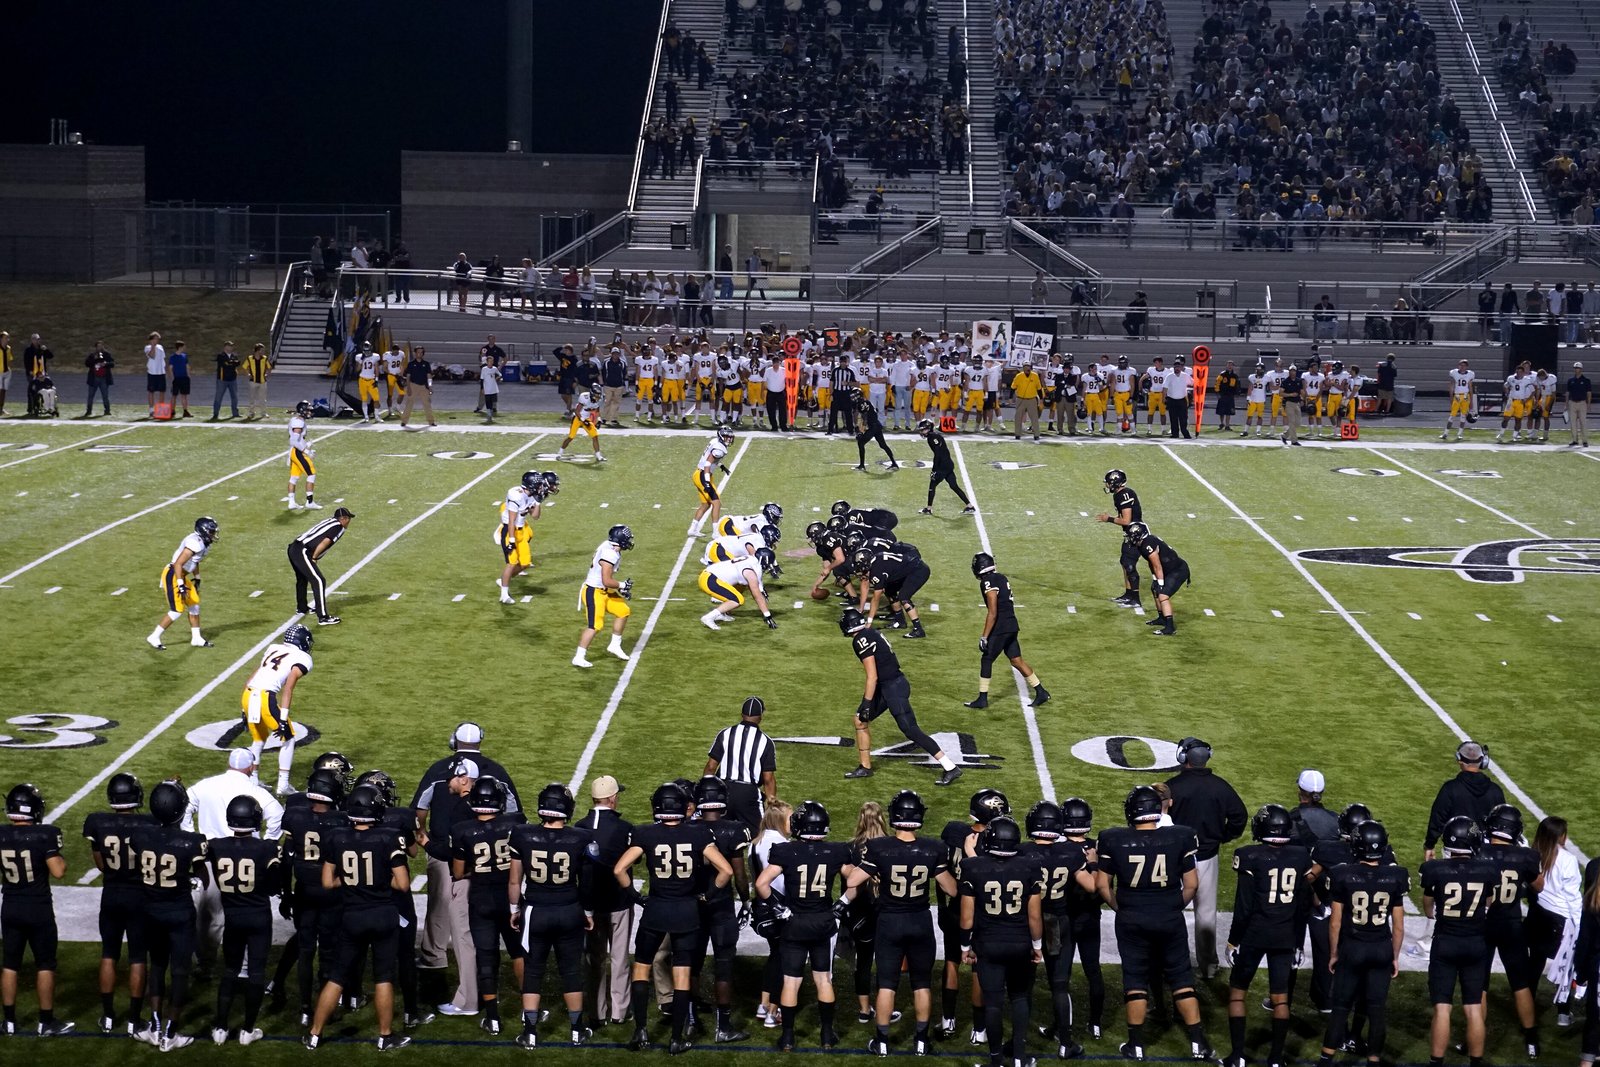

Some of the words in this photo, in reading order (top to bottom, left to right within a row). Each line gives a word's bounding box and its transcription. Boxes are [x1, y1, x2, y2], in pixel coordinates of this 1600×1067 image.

[826, 331, 839, 347] 3
[642, 364, 653, 372] 43
[859, 367, 870, 377] 92
[938, 373, 950, 382] 20
[971, 374, 983, 383] 47
[1117, 374, 1126, 384] 91
[1308, 380, 1319, 390] 44
[942, 419, 956, 430] 40
[1342, 424, 1358, 437] 50
[826, 537, 837, 548] 54
[1146, 545, 1154, 554] 3
[857, 636, 869, 649] 12
[262, 650, 290, 672] 14
[104, 835, 137, 871] 31
[304, 831, 321, 861] 6
[654, 843, 694, 879] 35
[1, 849, 35, 884] 51
[141, 850, 178, 888] 82
[217, 857, 256, 894] 29
[342, 850, 374, 887] 91
[530, 849, 571, 885] 53
[797, 863, 827, 899] 14
[889, 864, 929, 898] 52
[1128, 854, 1169, 888] 74
[984, 880, 1024, 915] 33
[1268, 867, 1297, 904] 19
[1442, 882, 1485, 918] 27
[1491, 869, 1519, 904] 6
[1351, 890, 1391, 926] 83
